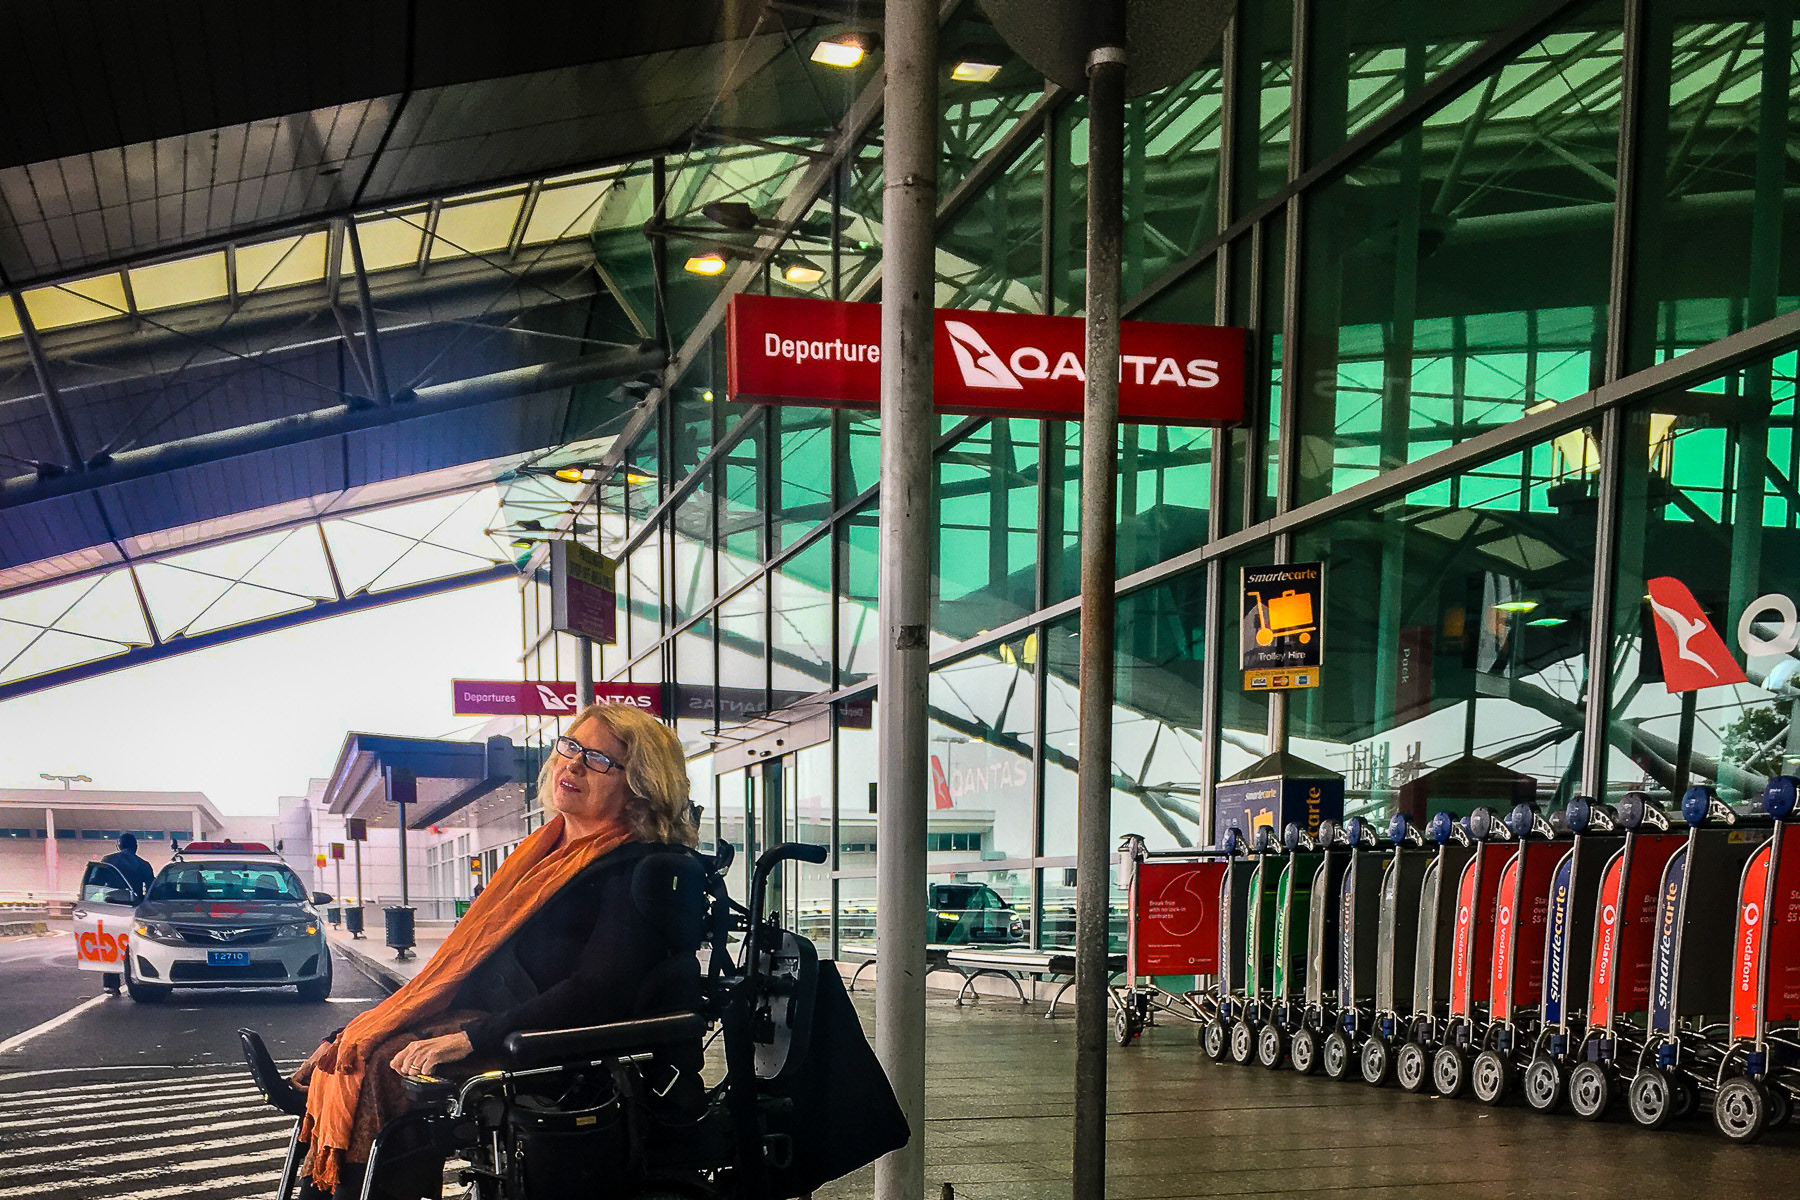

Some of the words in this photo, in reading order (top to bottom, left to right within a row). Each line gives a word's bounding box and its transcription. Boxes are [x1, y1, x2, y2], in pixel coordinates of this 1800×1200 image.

[765, 333, 880, 364] Departure
[1010, 346, 1219, 388] QATAS
[1247, 569, 1317, 583] smartecarte
[1258, 652, 1286, 661] Trolley
[1288, 651, 1306, 659] Hire
[464, 692, 516, 703] Departures
[563, 694, 652, 707] QNTAS
[951, 761, 1028, 797] QANTAS
[74, 919, 129, 962] abs
[1342, 892, 1351, 991] smartecarte
[1457, 927, 1465, 977] vodafone
[1497, 928, 1506, 980] vodafone
[1550, 885, 1566, 1004] smartecarte
[1599, 928, 1611, 985] vodafone
[1659, 882, 1678, 1010] smartecarte
[1741, 928, 1754, 992] vodafone
